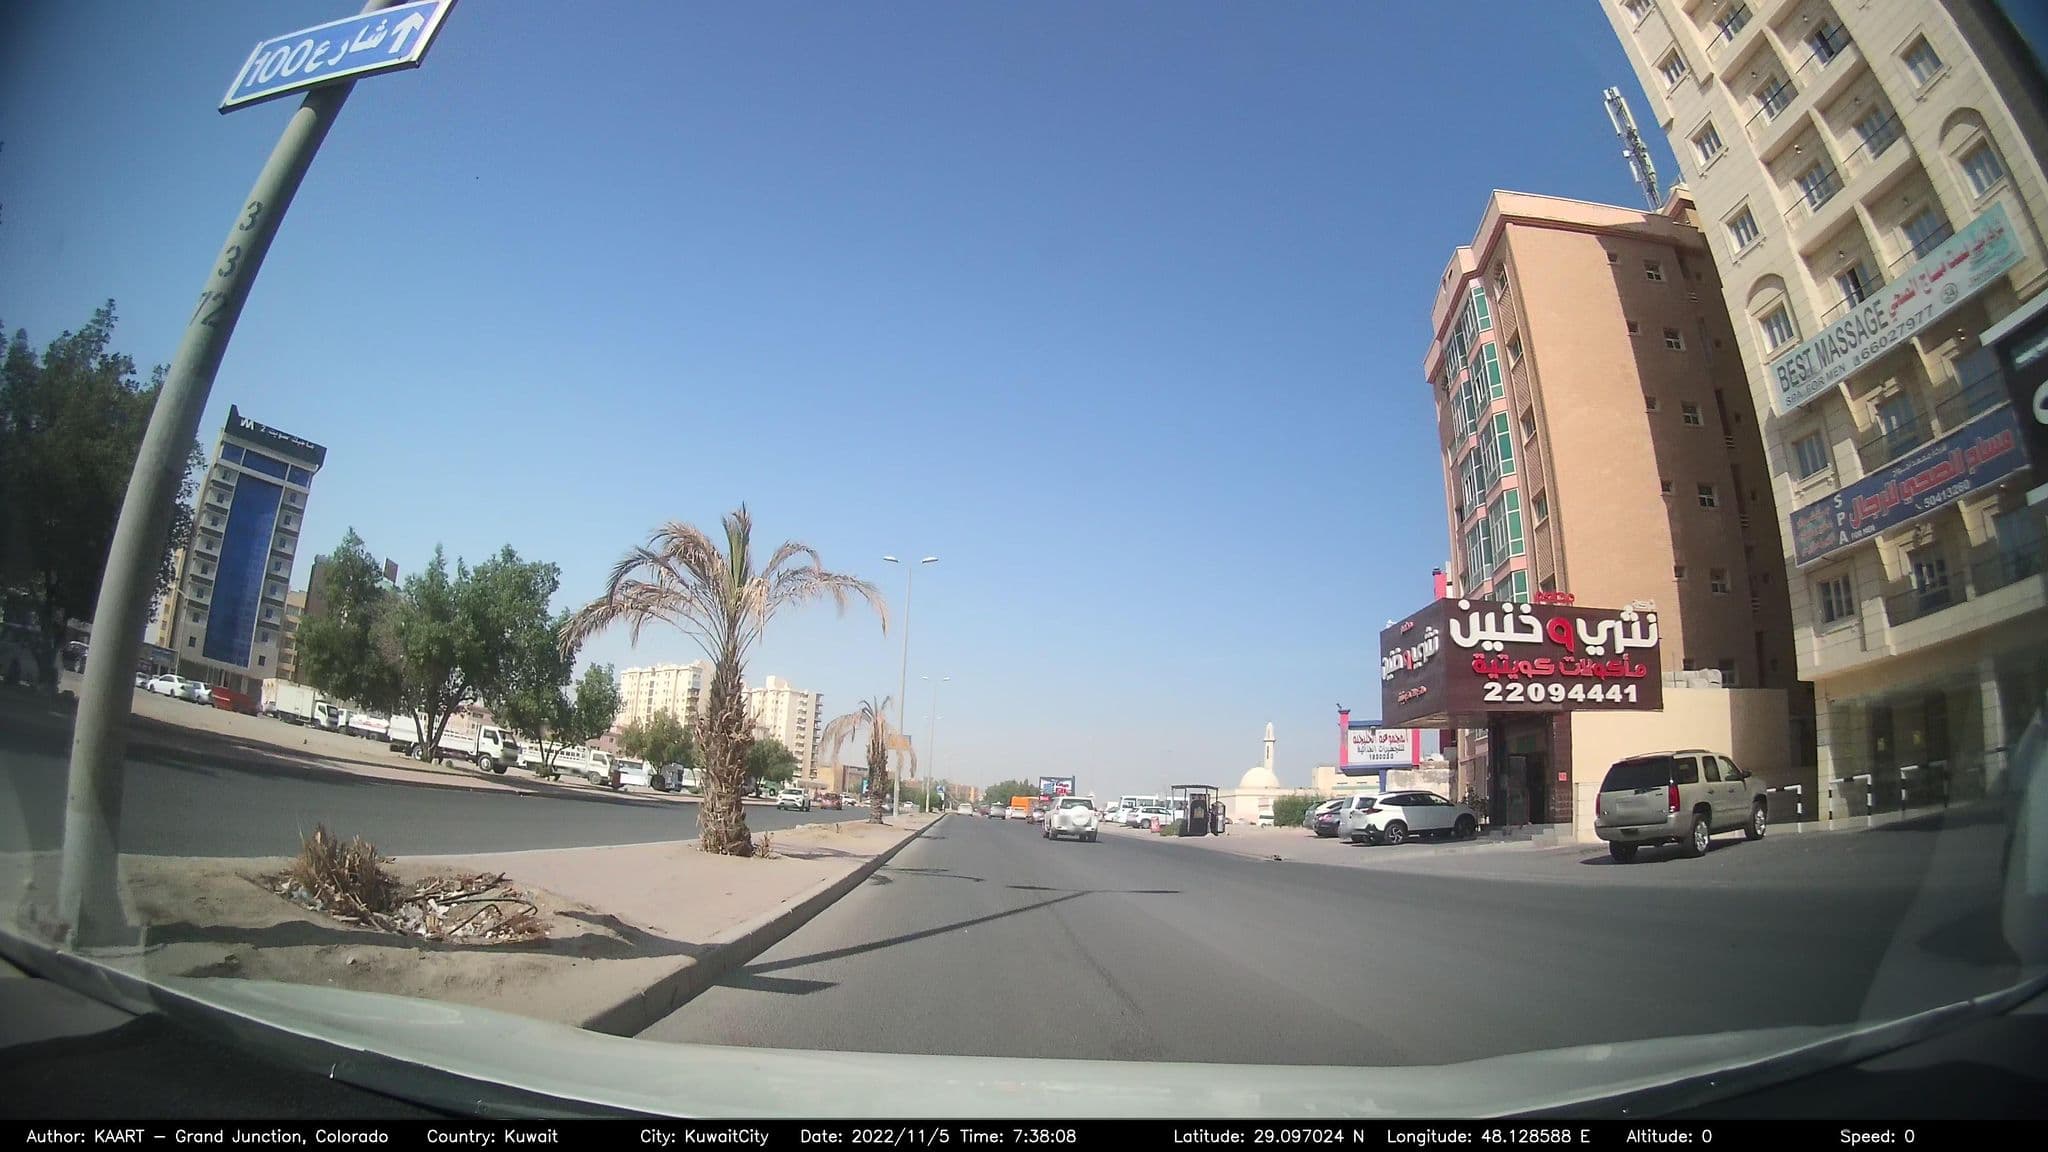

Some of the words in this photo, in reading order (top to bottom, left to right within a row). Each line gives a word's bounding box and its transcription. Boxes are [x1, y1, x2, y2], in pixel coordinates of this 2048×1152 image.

[247, 39, 314, 87] 100
[304, 19, 388, 73] شارع
[240, 200, 263, 231] 3
[218, 245, 241, 277] 3
[1777, 347, 1815, 393] BEST
[1815, 299, 1889, 370] MASSAGE
[1861, 304, 1934, 361] 66027977
[1450, 600, 1544, 651] خنين
[1546, 617, 1575, 653] و
[1576, 605, 1659, 656] نثري
[1472, 653, 1555, 680] كويتية
[1559, 653, 1647, 681] مأكولات
[1483, 682, 1637, 702] 22094441
